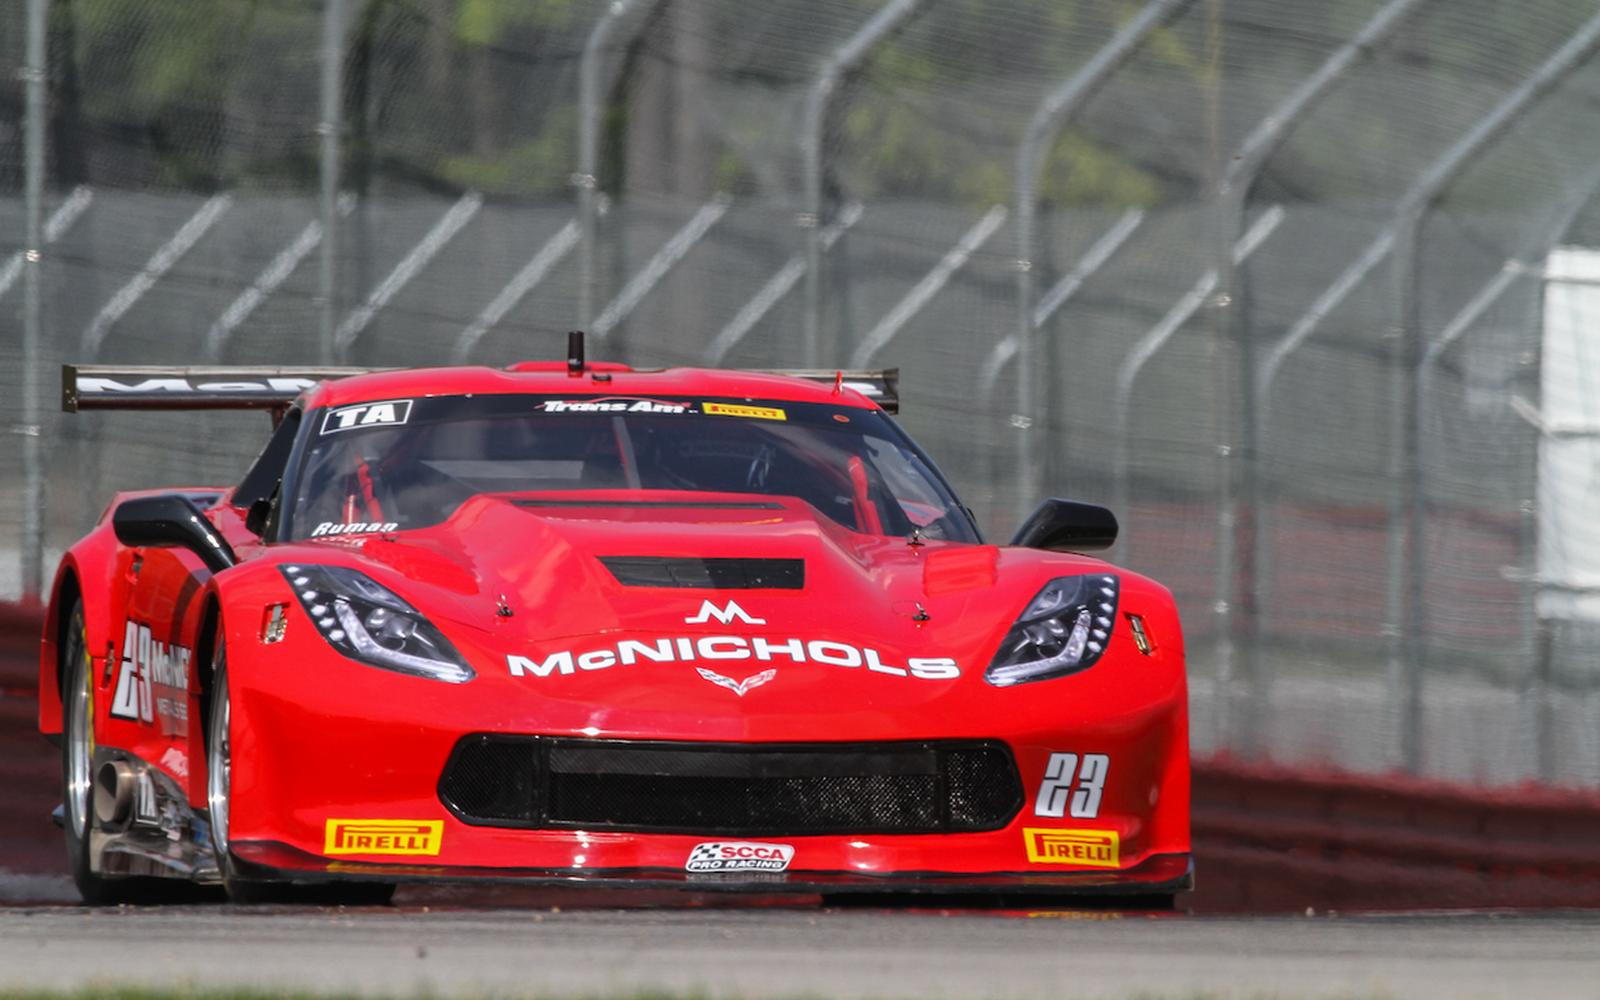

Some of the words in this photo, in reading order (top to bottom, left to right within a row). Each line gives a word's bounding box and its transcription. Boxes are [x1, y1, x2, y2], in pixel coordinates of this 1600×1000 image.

[336, 404, 396, 428] TA
[543, 400, 627, 413] Trans
[628, 401, 685, 414] Am
[311, 522, 398, 536] Ruman
[506, 636, 961, 680] McNICHOLS
[110, 619, 154, 723] 23
[1034, 752, 1110, 818] 23
[334, 825, 432, 849] PIRELLI
[1033, 833, 1112, 861] PIRELLI
[690, 860, 722, 869] PRO
[725, 860, 783, 869] RACING
[720, 846, 785, 860] SCCA
